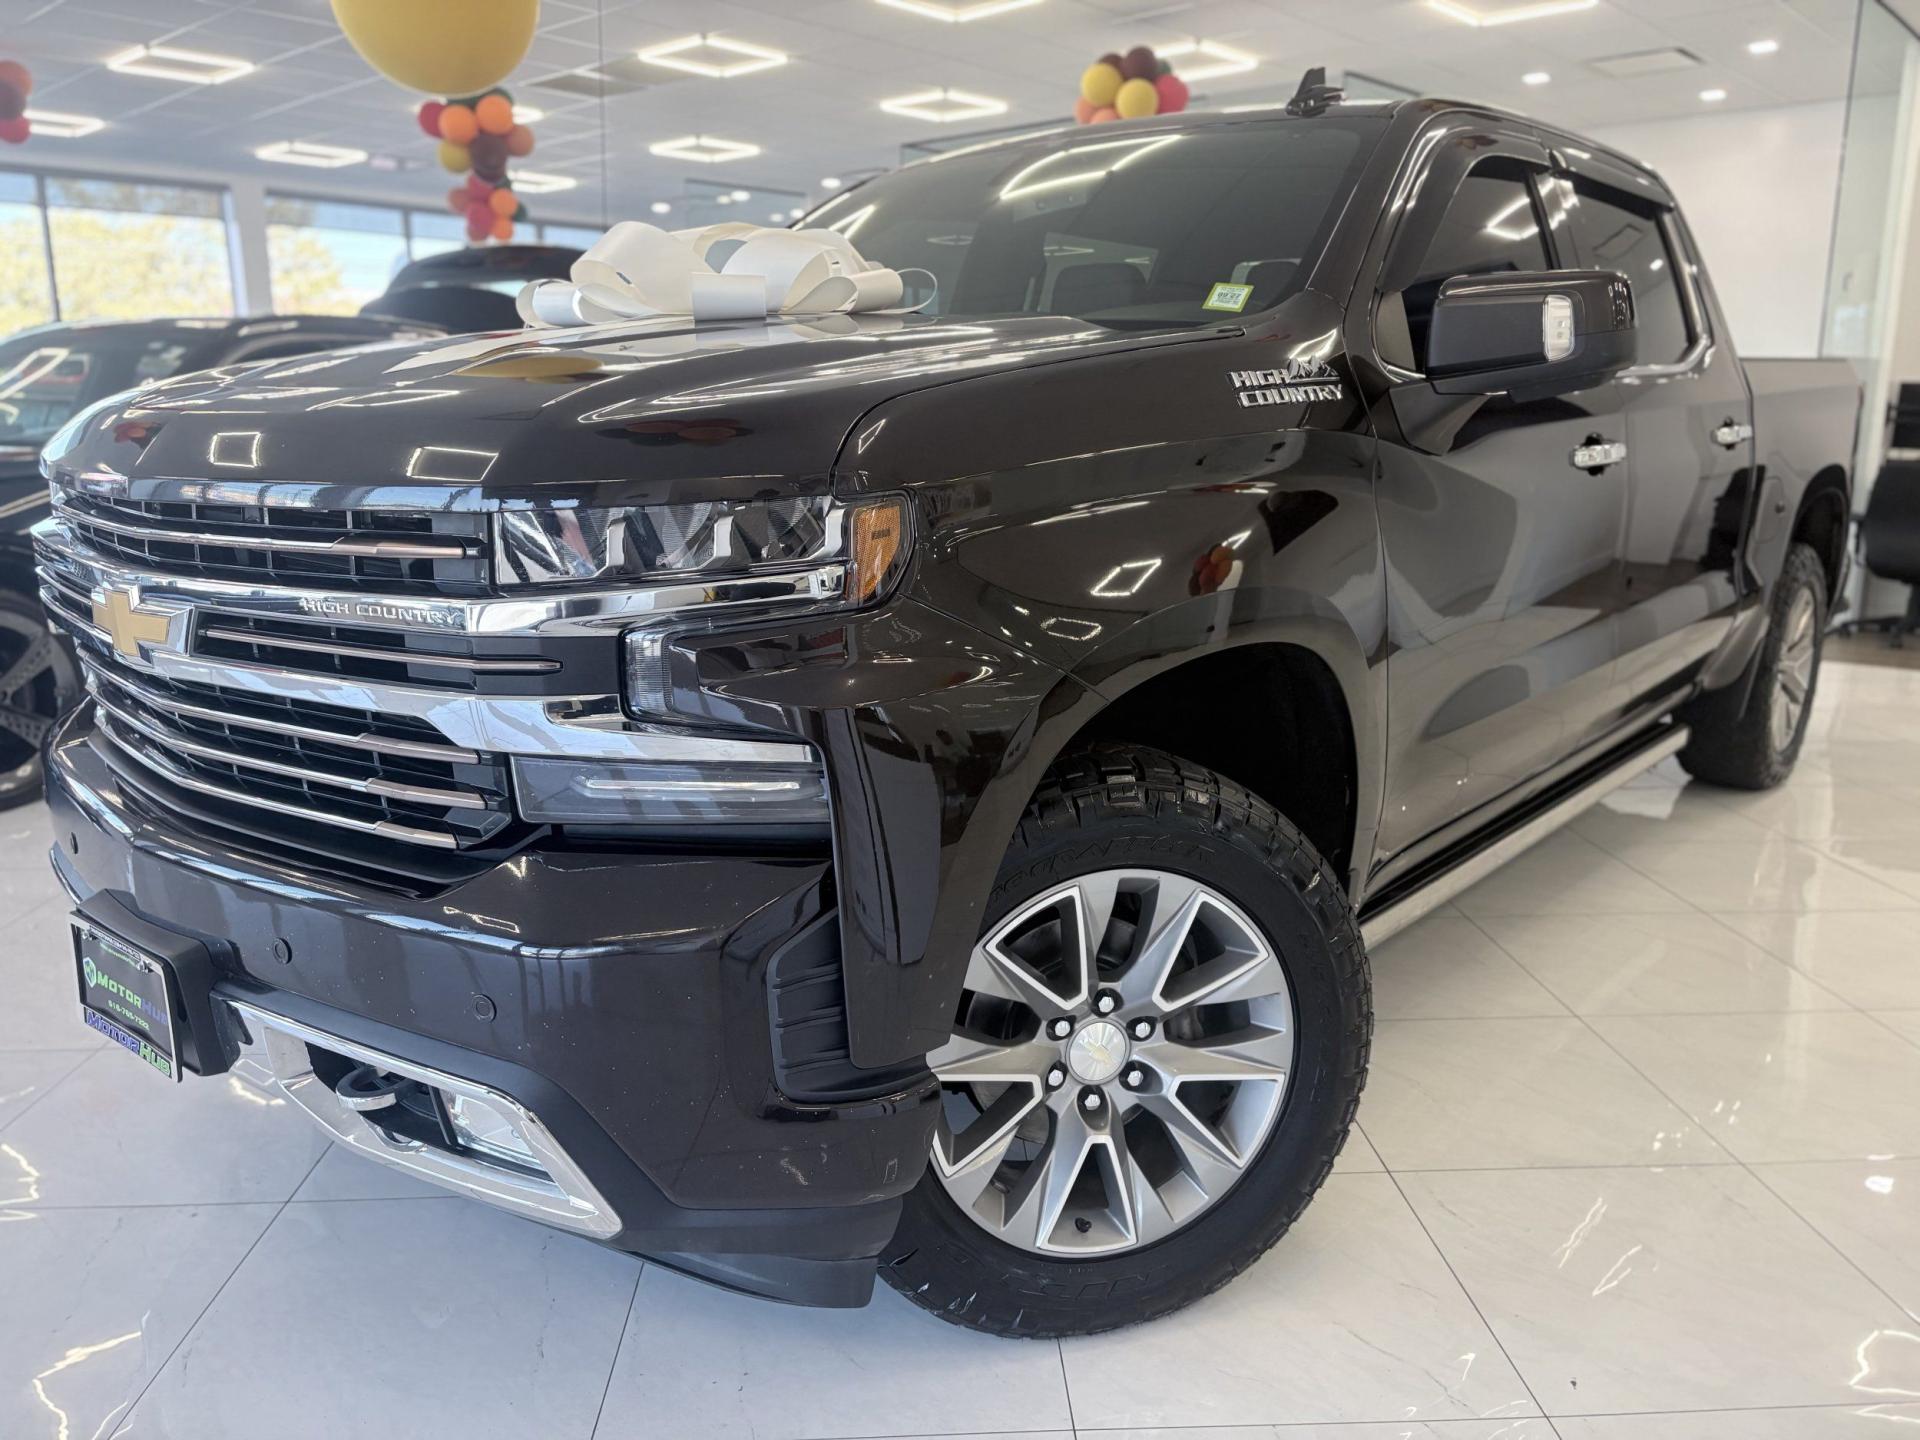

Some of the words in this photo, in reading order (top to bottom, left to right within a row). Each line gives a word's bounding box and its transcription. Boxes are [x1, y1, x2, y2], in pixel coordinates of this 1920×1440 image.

[1229, 368, 1292, 388] HIGH
[1239, 383, 1344, 408] COUNTRY
[299, 597, 349, 615] HIGH
[356, 604, 460, 626] COUNTRY
